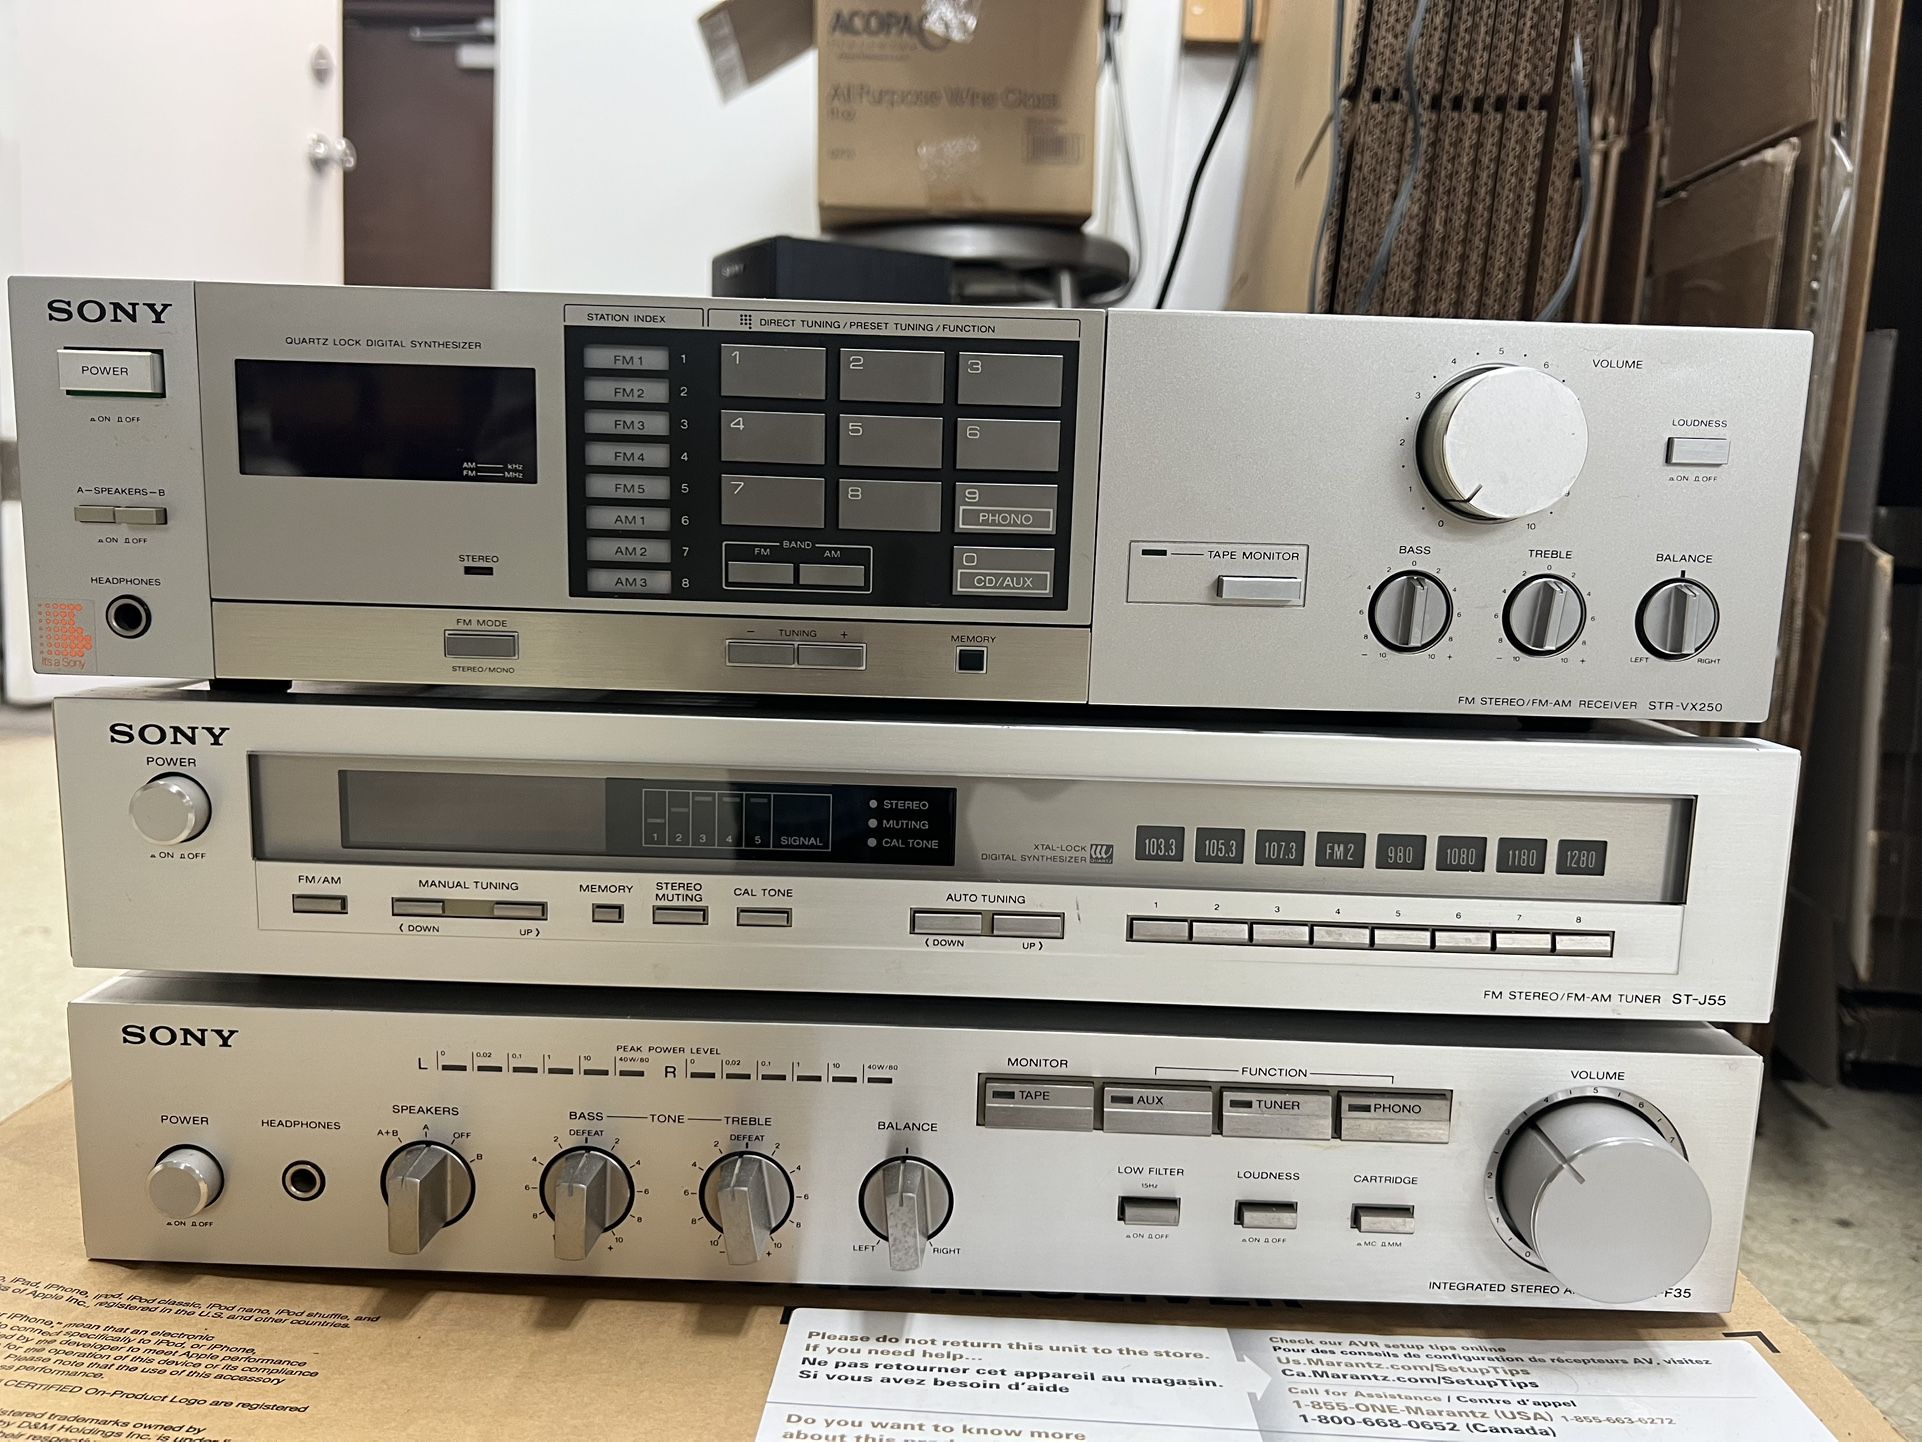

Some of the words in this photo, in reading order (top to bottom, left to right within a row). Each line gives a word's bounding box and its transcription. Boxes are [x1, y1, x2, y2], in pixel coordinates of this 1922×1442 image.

[47, 300, 172, 324] SONY
[586, 312, 629, 324] STATION
[634, 314, 666, 324] INDEX
[759, 317, 796, 328] DIRECT
[285, 336, 329, 347] QUARTZ
[333, 337, 362, 347] LOCK
[366, 338, 406, 348] DIGITAL
[410, 340, 482, 350] SYNTHESIZER
[731, 351, 741, 364] 1
[849, 356, 864, 370] 2
[81, 365, 129, 376] POWER
[967, 360, 982, 374] 3
[1592, 360, 1643, 370] VOLUME
[730, 417, 745, 431] 4
[848, 422, 863, 436] 5
[1672, 419, 1728, 429] LOUDNESS
[966, 425, 980, 439] 6
[731, 481, 745, 495] 7
[848, 486, 862, 500] 8
[965, 489, 979, 502] 9
[979, 513, 1033, 525] PHONO
[782, 540, 812, 549] BAND
[754, 547, 770, 556] FM
[824, 550, 841, 558] AM
[1207, 550, 1237, 561] TAPE
[1241, 551, 1300, 562] MONITOR
[1399, 545, 1432, 556] BASS
[1528, 549, 1573, 560] TREBLE
[458, 554, 499, 564] STEREO
[963, 552, 977, 566] 0
[1656, 553, 1714, 565] BALANCE
[90, 576, 161, 586] HEADPHONES
[974, 575, 1033, 588] CD/AUX
[456, 618, 472, 627] FM
[477, 618, 508, 628] MODE
[778, 629, 818, 638] TUNING
[950, 634, 996, 644] MEMORY
[1630, 656, 1649, 665] LEFT
[451, 665, 515, 674] STEREO/MONO
[1458, 696, 1476, 706] FM
[1480, 696, 1573, 709] STEREO/FM-AM
[1578, 699, 1638, 711] RECEIVER
[1648, 700, 1724, 713] STR-VX250
[109, 723, 230, 746] SONY
[146, 757, 198, 767] POWER
[883, 800, 929, 810] STEREO
[882, 819, 929, 830] MUTING
[780, 836, 823, 847] SIGNAL
[882, 838, 904, 848] CAL
[907, 839, 939, 849] TONE
[1143, 837, 1177, 857] 103.3
[1033, 843, 1087, 853] XTAL-LOCK
[1203, 838, 1237, 859] 105.3
[1263, 840, 1296, 860] 107.3
[1326, 843, 1344, 860] FM
[1347, 843, 1354, 860] 2
[981, 853, 1016, 862] DIGITAL
[1020, 854, 1088, 864] SYNTHESIZER
[1387, 844, 1414, 864] 980
[1446, 846, 1477, 866] 1080
[1506, 848, 1537, 868] 1180
[1564, 849, 1596, 869] 1280
[298, 874, 342, 886] FM/AM
[418, 878, 469, 891] MANUAL
[473, 880, 519, 892] TUNING
[578, 884, 634, 894] MEMORY
[655, 882, 704, 892] STEREO
[733, 887, 757, 898] CAL
[761, 888, 794, 898] TONE
[654, 893, 704, 903] MUTING
[945, 894, 978, 904] AUTO
[980, 894, 1026, 905] TUNING
[408, 924, 440, 934] DOWN
[519, 928, 533, 937] UP
[932, 939, 965, 949] DOWN
[1022, 942, 1036, 950] UP
[1483, 990, 1502, 1000] FM
[1507, 990, 1612, 1003] STEREO/FM-AM
[1617, 993, 1661, 1004] TUNER
[1671, 993, 1727, 1007] ST-J55
[122, 1025, 239, 1048] SONY
[616, 1044, 643, 1053] PEAK
[648, 1046, 686, 1054] POWER
[690, 1047, 722, 1055] LEVEL
[1007, 1057, 1069, 1069] MONITOR
[1241, 1067, 1308, 1078] FUNCTION
[1571, 1070, 1625, 1081] VOLUME
[1019, 1090, 1051, 1101] TAPE
[1137, 1095, 1164, 1105] AUX
[1256, 1099, 1301, 1110] TUNER
[1373, 1103, 1422, 1115] PHONO
[392, 1105, 460, 1116] SPEAKERS
[160, 1115, 210, 1126] POWER
[569, 1111, 604, 1122] BASS
[649, 1114, 685, 1124] TONE
[724, 1116, 772, 1127] TREBLE
[261, 1120, 342, 1130] HEADPHONES
[877, 1121, 938, 1133] BALANCE
[377, 1129, 399, 1138] A+B
[453, 1132, 472, 1140] OFF
[569, 1128, 604, 1137] DEFEAT
[730, 1134, 765, 1142] DEFEAT
[1117, 1166, 1144, 1176] LOW
[1148, 1166, 1185, 1177] FILTER
[1237, 1170, 1301, 1181] LOUDNESS
[1353, 1174, 1418, 1186] CARTRIDGE
[852, 1244, 876, 1253] LEFT
[932, 1247, 961, 1256] RIGHT
[1428, 1281, 1506, 1292] INTEGRATED
[1511, 1284, 1560, 1294] STEREO
[807, 1330, 870, 1343] Please
[875, 1334, 899, 1344] do
[904, 1336, 937, 1347] not
[942, 1339, 1002, 1349] return
[1007, 1342, 1044, 1351] this
[1049, 1344, 1088, 1354] unit
[1094, 1346, 1112, 1355] to
[1117, 1346, 1148, 1357] the
[1154, 1349, 1210, 1360] store.
[1276, 1356, 1530, 1376] Us.Marantz.com/SetupTips
[801, 1356, 829, 1370] Ne
[834, 1360, 869, 1374] pas
[874, 1361, 969, 1376] retourner
[976, 1367, 1007, 1378] cet
[1014, 1370, 1095, 1381] appareil
[1102, 1374, 1126, 1382] au
[1132, 1376, 1224, 1388] magasin.
[1281, 1368, 1540, 1389] Ca.Marantz.com/SetupTips
[4, 1379, 83, 1394] CERTIFIED
[84, 1387, 168, 1402] On-Product
[169, 1395, 207, 1406] Logo
[209, 1399, 234, 1408] are
[236, 1401, 309, 1414] registered
[1292, 1400, 1490, 1420] 1-855-ONE-Marantz
[1494, 1408, 1554, 1422] (USA)
[1299, 1414, 1460, 1432] 1-800-668-0652
[1466, 1422, 1556, 1438] (Canada)
